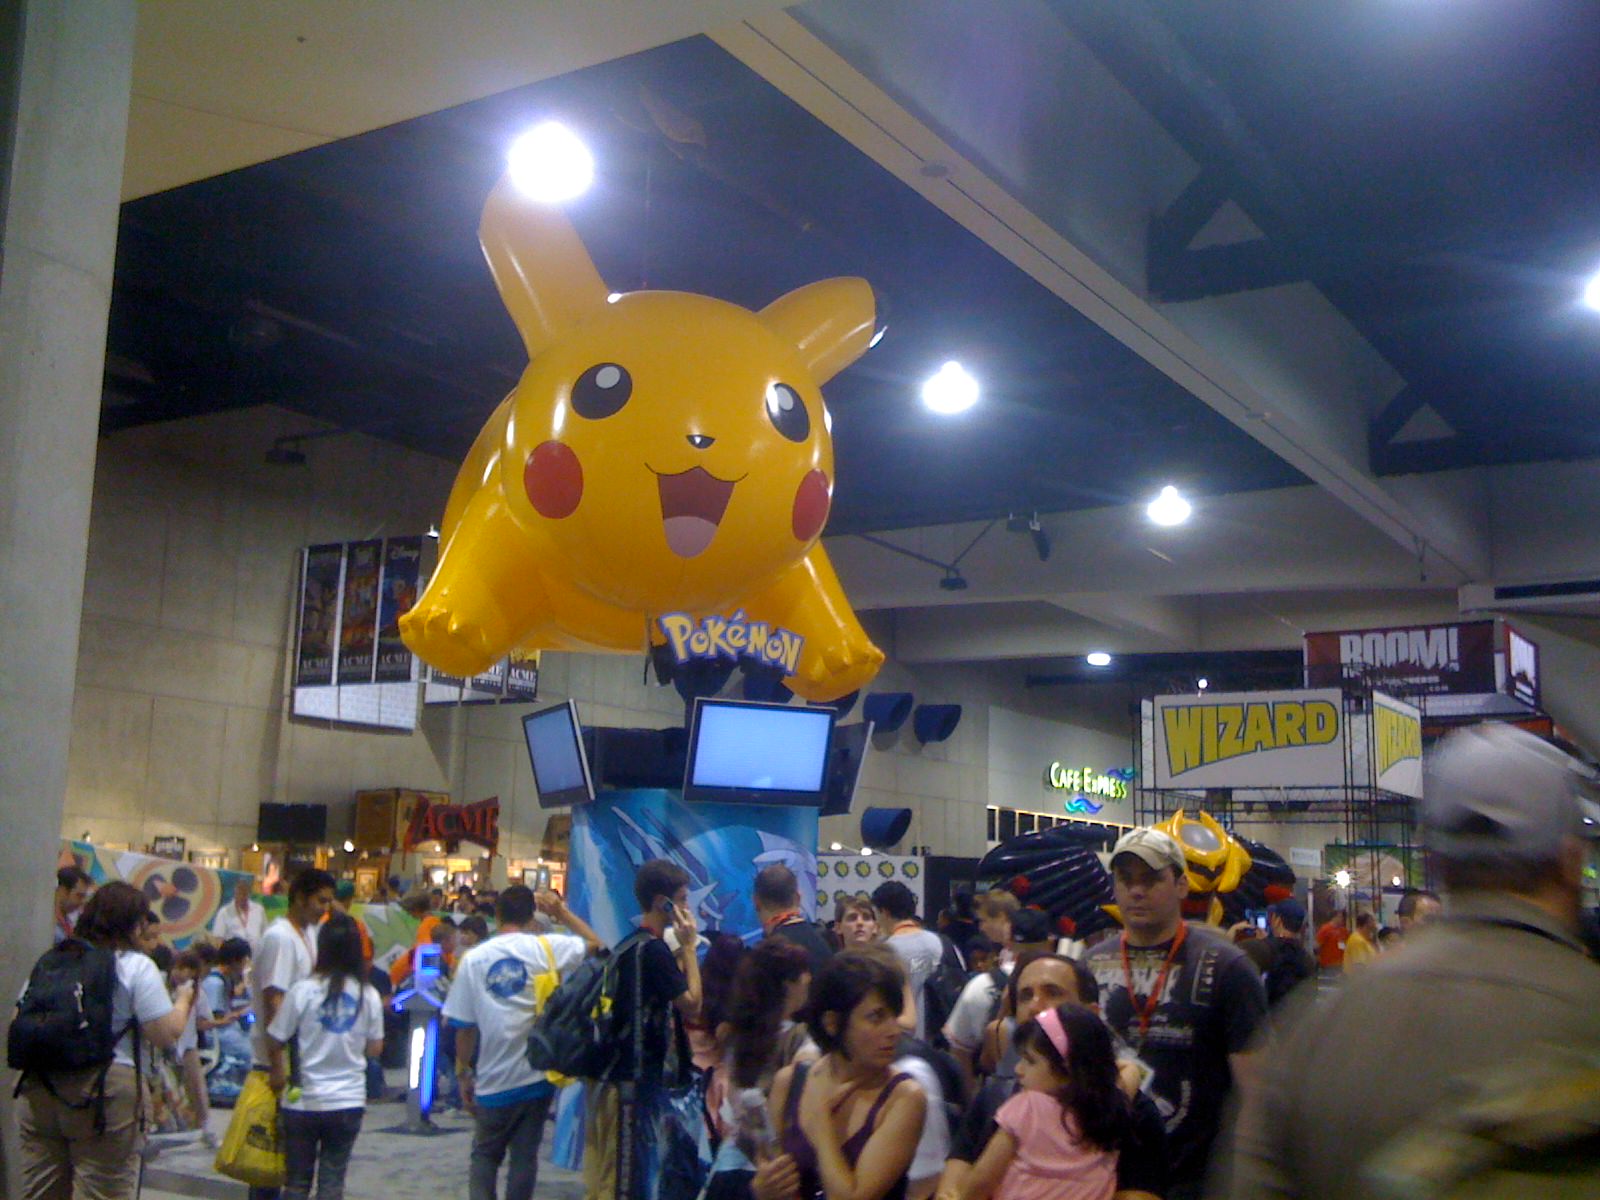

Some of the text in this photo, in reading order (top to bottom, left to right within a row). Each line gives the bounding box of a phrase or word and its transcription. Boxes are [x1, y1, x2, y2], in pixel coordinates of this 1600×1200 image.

[1340, 627, 1459, 677] BOOM!
[510, 667, 537, 681] ACME
[1161, 700, 1339, 777] WIZARD
[421, 806, 499, 841] ACME
